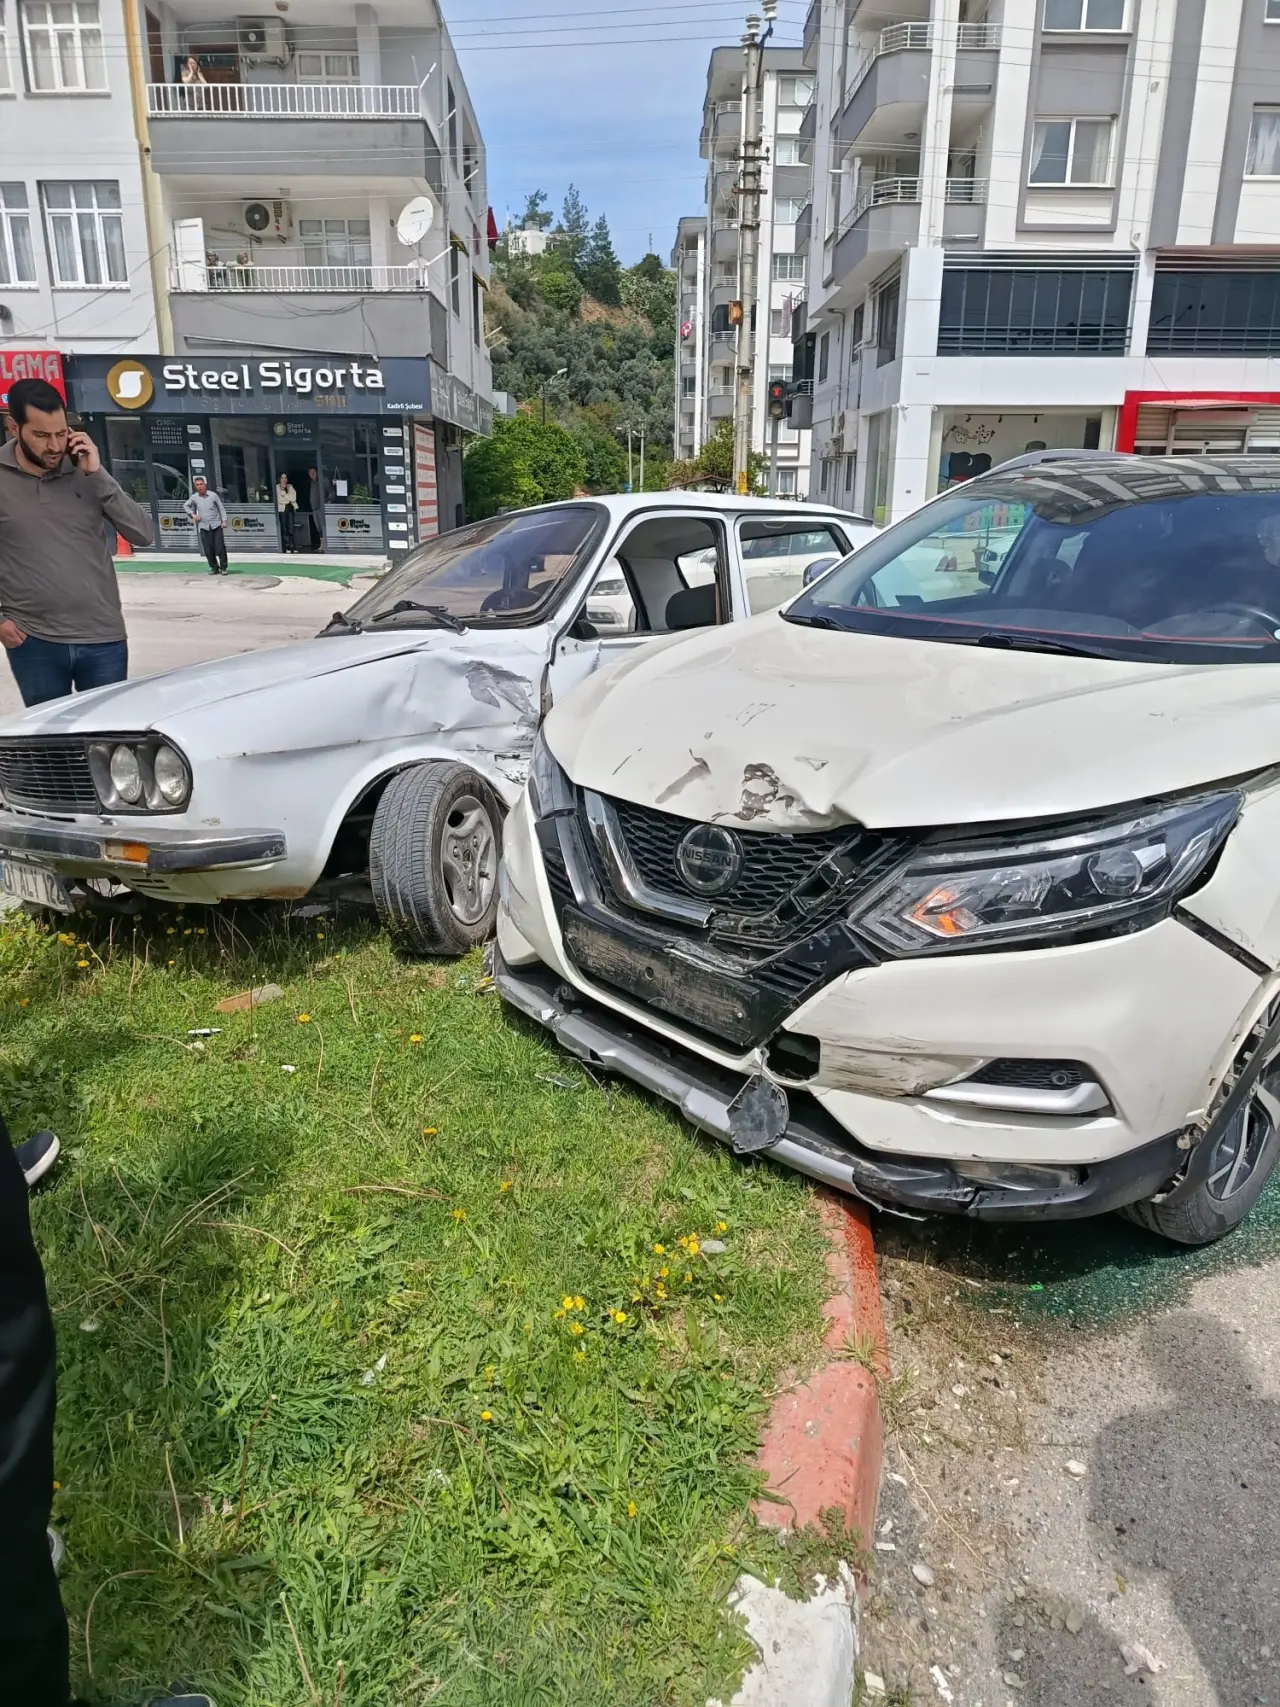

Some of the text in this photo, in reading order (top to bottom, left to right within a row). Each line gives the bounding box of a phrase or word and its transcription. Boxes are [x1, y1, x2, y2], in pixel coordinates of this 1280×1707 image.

[162, 361, 385, 393] Steel Sigorta
[682, 847, 732, 867] NISSAN
